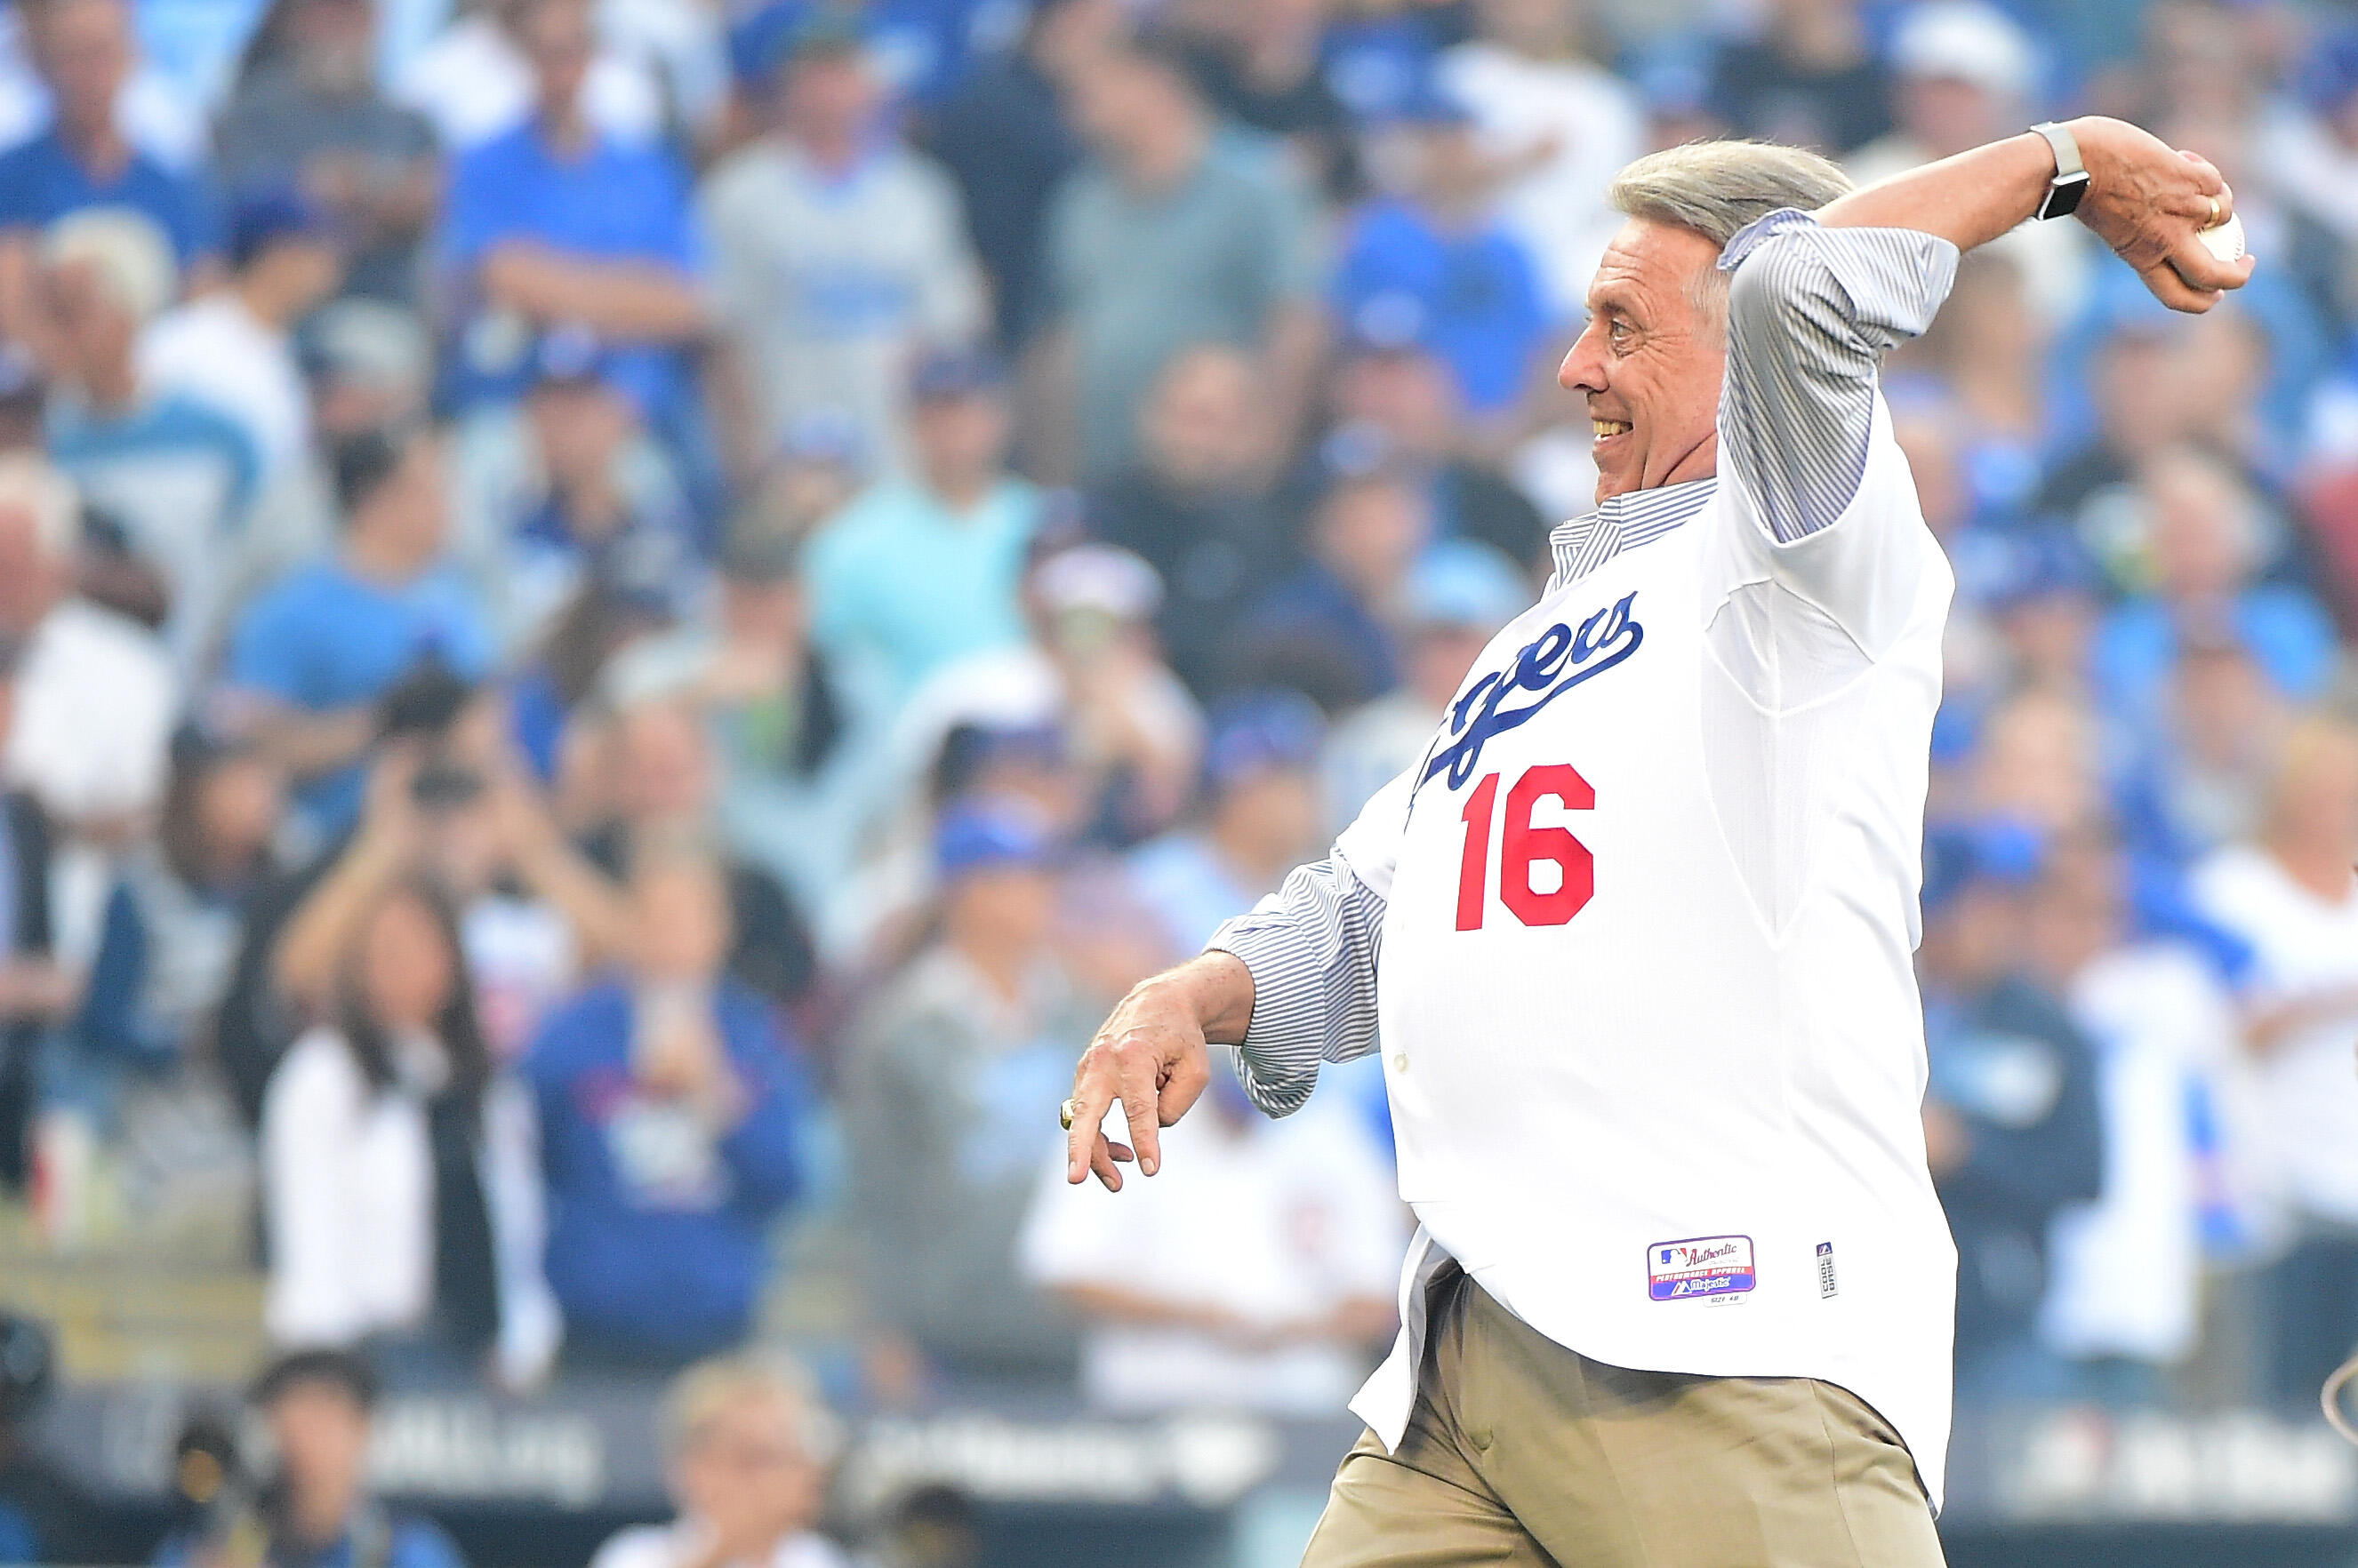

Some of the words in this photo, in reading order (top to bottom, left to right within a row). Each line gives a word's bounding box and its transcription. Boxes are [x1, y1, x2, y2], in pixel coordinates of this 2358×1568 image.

[1414, 590, 1645, 793] gers
[1456, 763, 1596, 932] 16
[1686, 1242, 1737, 1268] Authentic
[1691, 1277, 1730, 1292] Majestic
